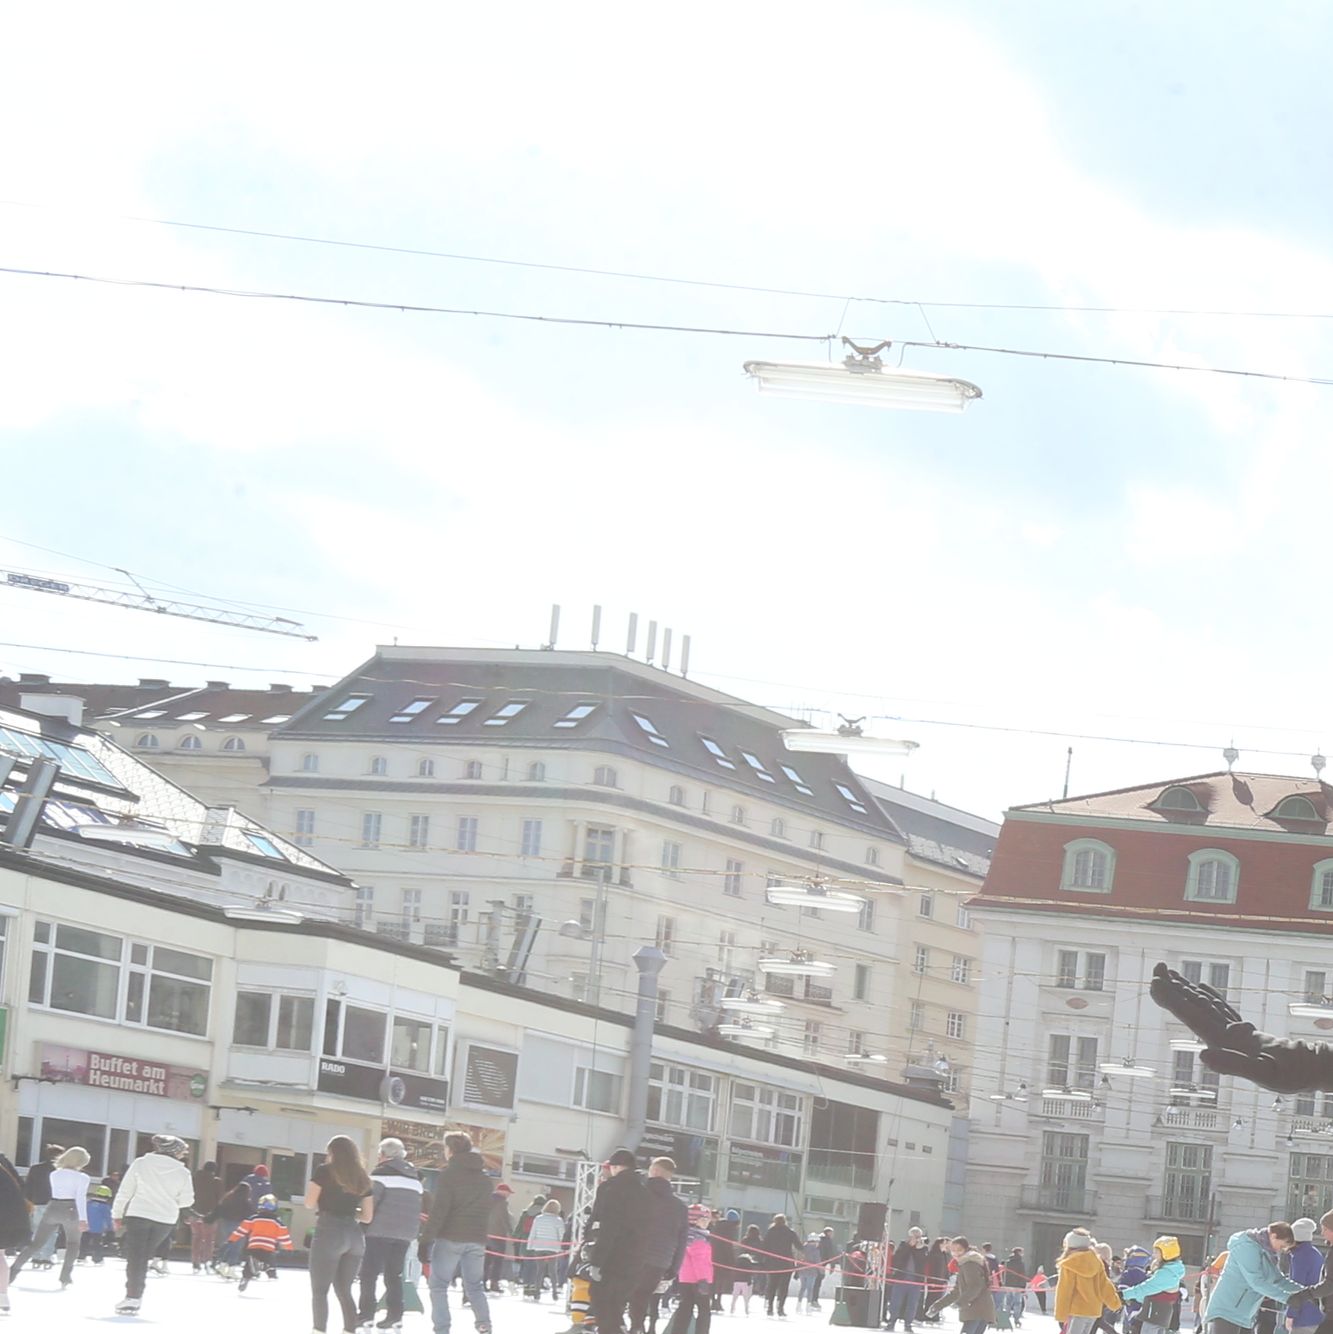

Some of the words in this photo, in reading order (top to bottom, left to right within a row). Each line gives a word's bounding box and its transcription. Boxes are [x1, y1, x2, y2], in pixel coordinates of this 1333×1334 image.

[90, 1054, 138, 1076] Buffet
[142, 1065, 166, 1080] am
[321, 1062, 346, 1073] RADO
[89, 1069, 166, 1095] Heumarkt
